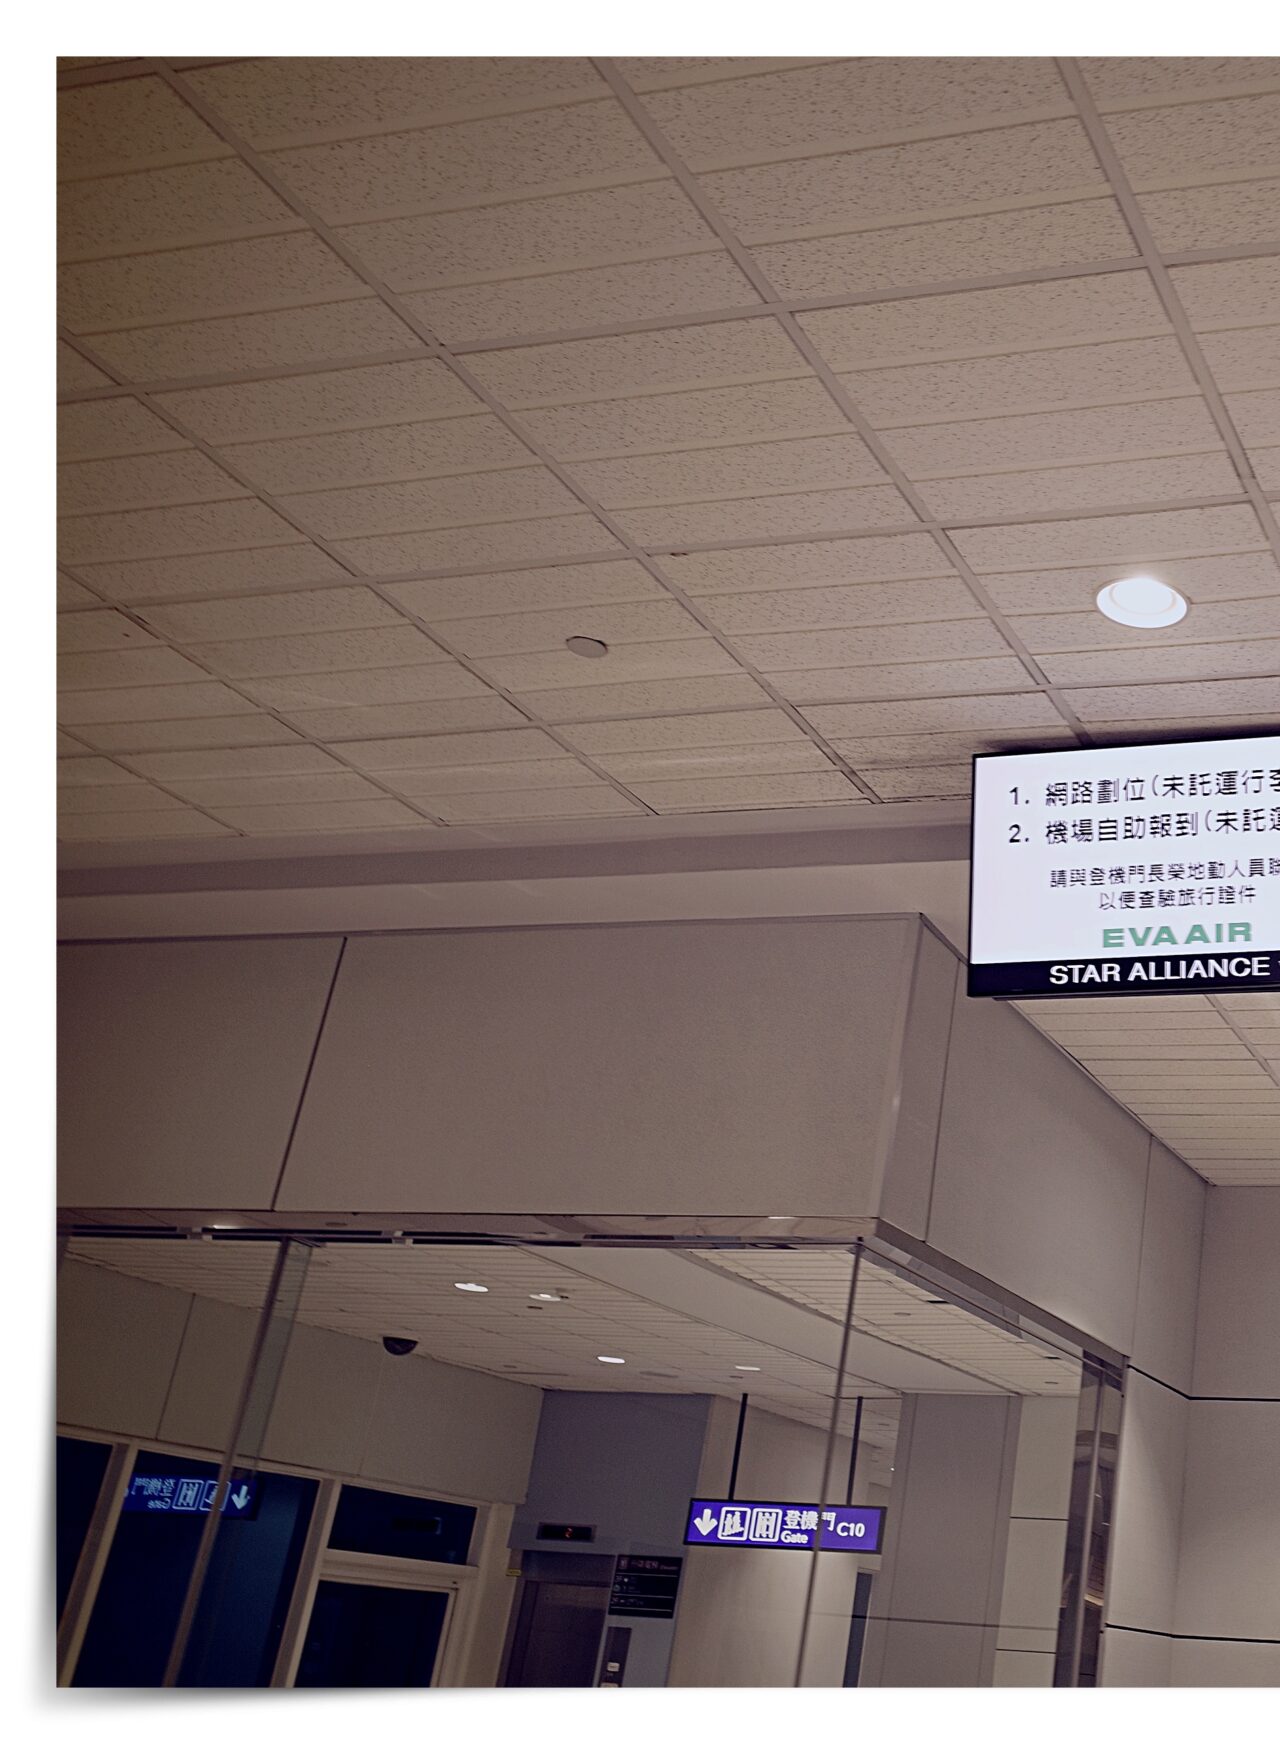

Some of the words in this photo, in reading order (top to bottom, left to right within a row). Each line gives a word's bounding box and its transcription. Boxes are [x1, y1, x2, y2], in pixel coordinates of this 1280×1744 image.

[1008, 786, 1030, 806] 1.
[1008, 823, 1030, 844] 2.
[1098, 884, 1257, 910] 以便查驗旅行證件
[1049, 963, 1121, 985] STAR
[1127, 956, 1271, 981] ALLIANCE
[783, 1509, 837, 1532] 登機門
[836, 1521, 866, 1538] C10
[780, 1530, 809, 1544] Gate
